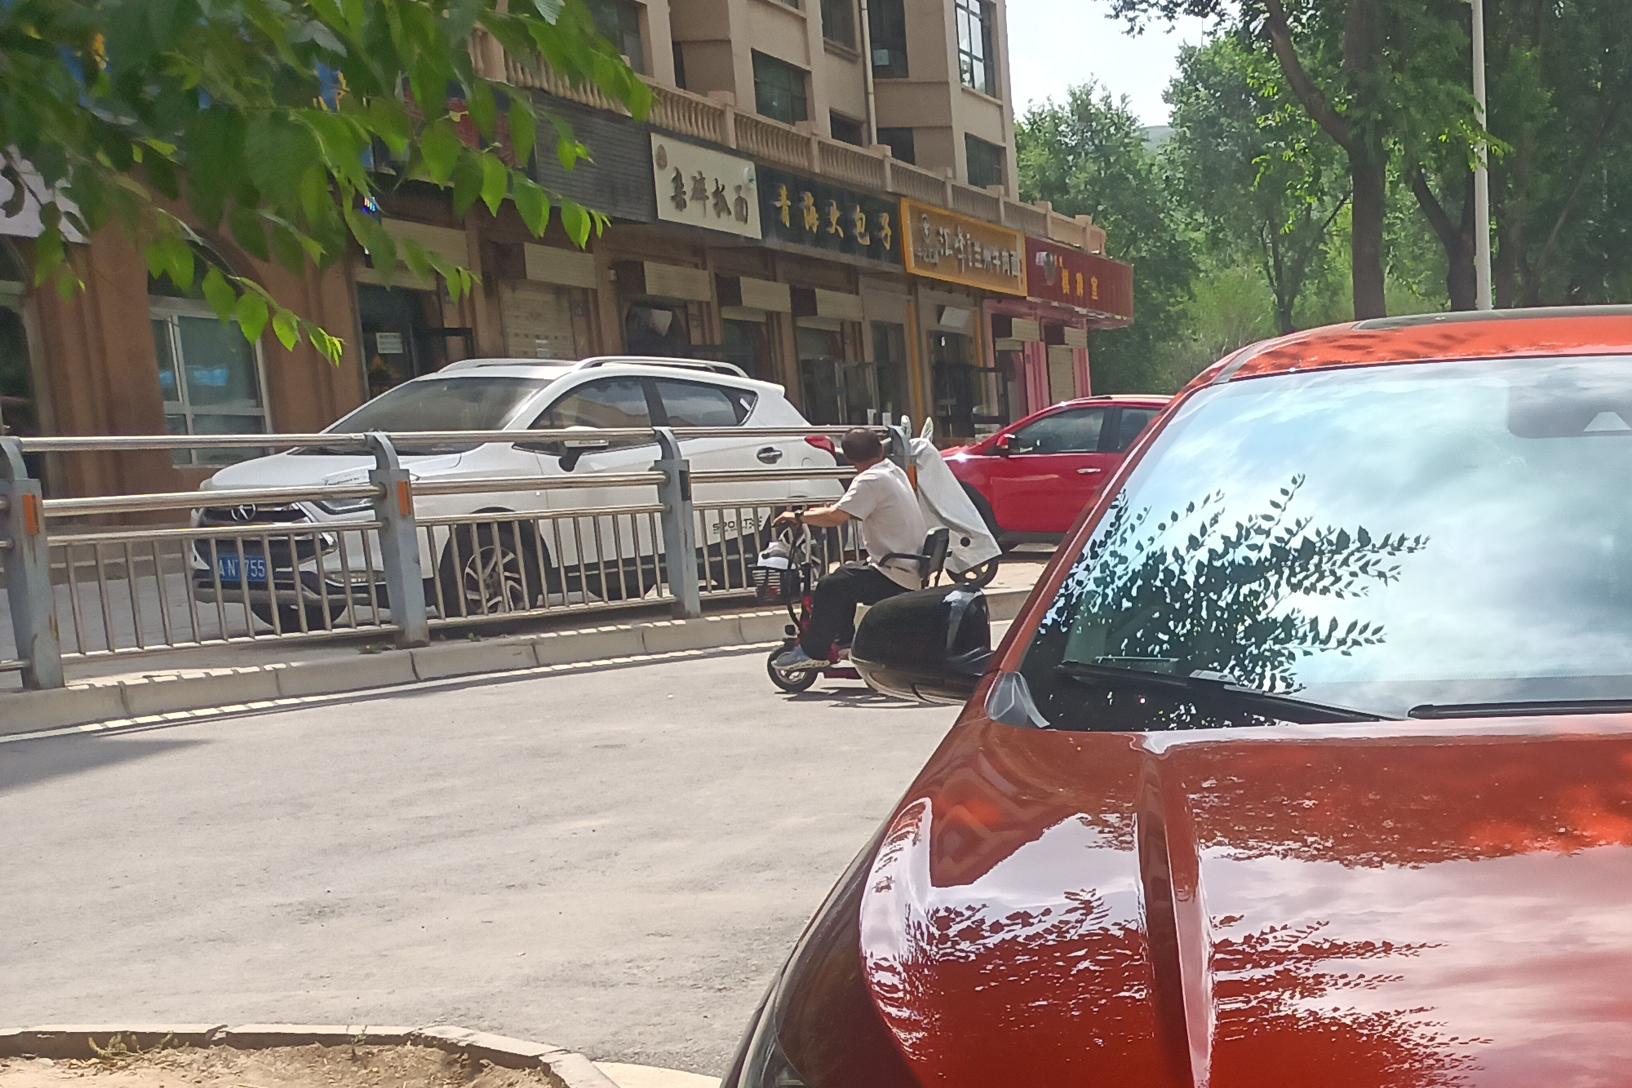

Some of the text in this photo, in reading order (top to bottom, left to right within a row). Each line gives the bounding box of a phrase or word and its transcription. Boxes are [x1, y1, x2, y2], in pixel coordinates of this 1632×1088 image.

[773, 184, 892, 251] 青海大包子
